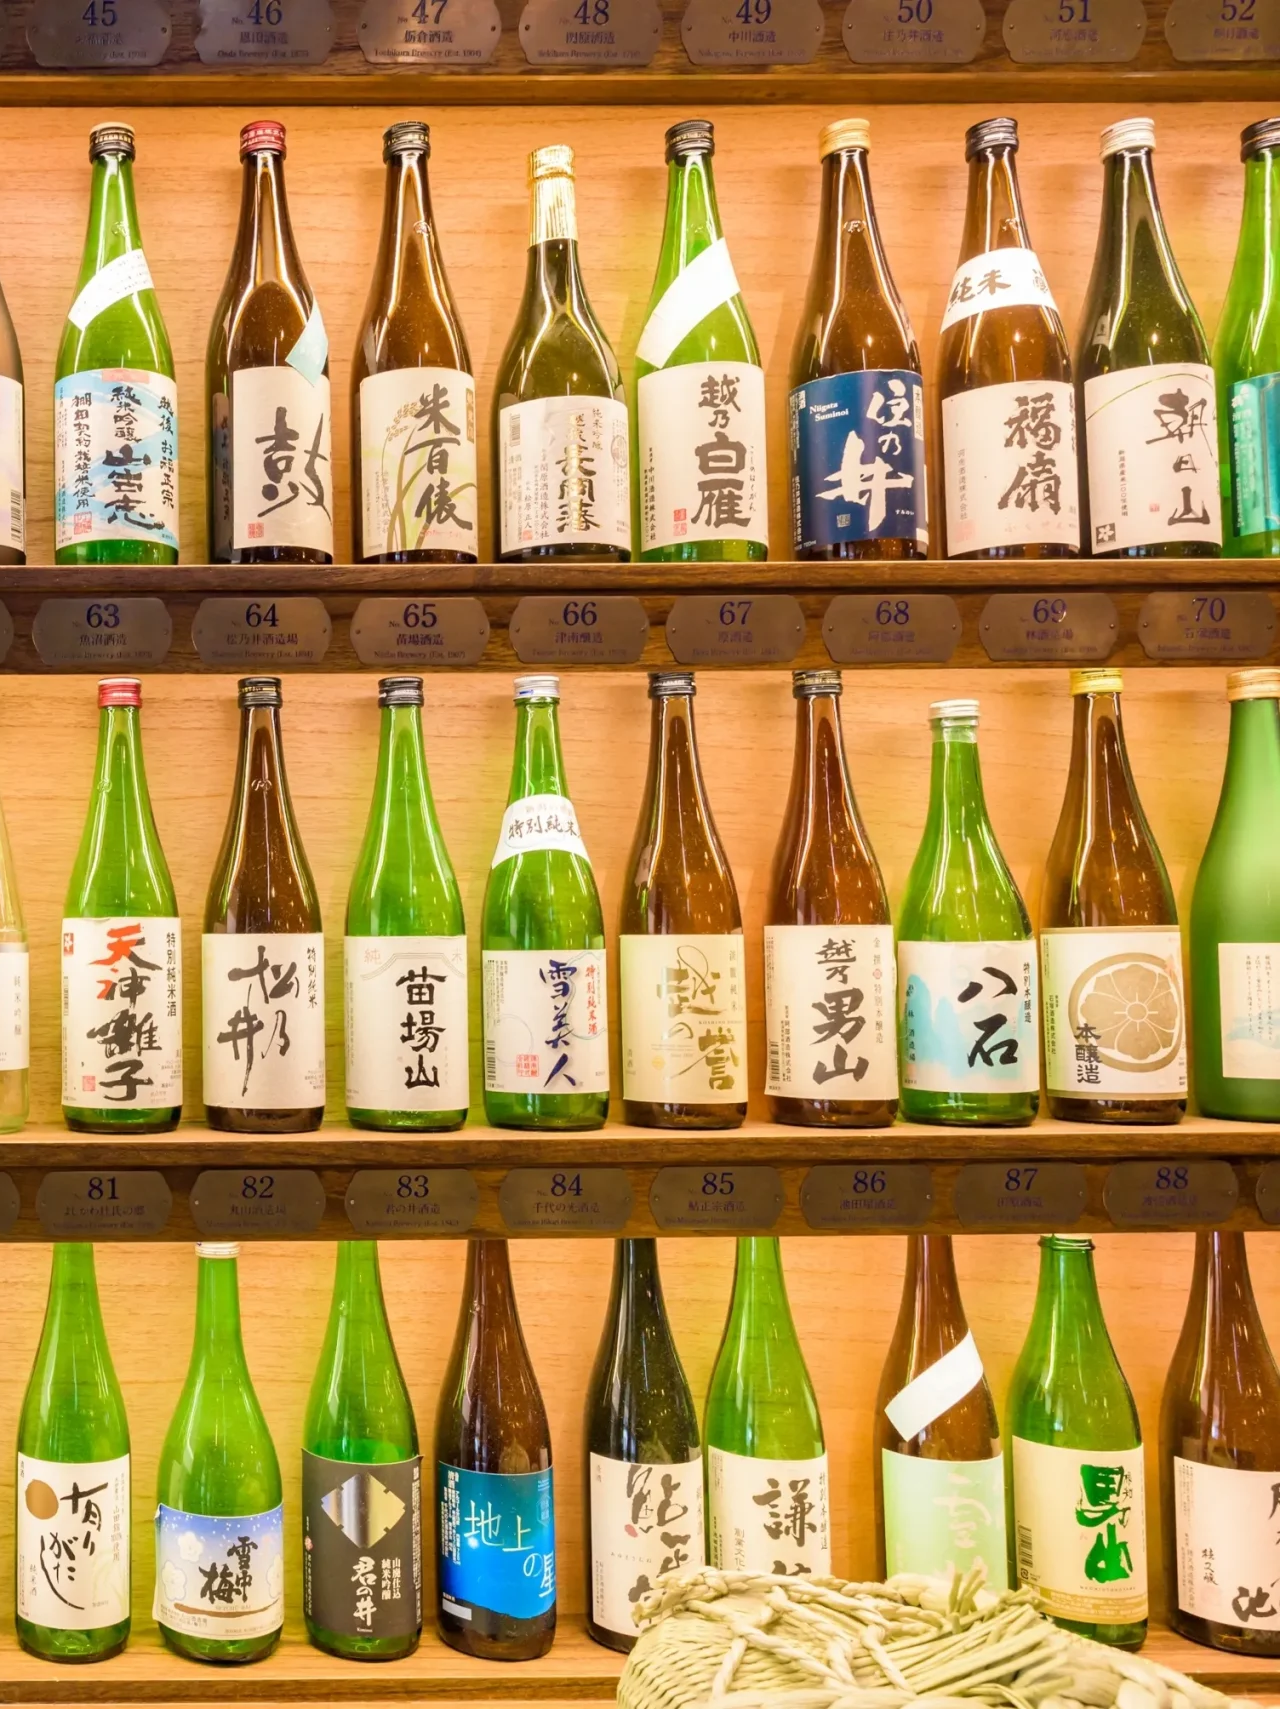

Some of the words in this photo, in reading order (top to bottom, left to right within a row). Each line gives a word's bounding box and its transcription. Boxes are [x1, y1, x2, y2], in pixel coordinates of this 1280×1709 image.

[82, 0, 118, 26] 45
[246, 0, 283, 25] 46
[411, 0, 448, 24] 47
[573, 0, 610, 25] 48
[735, 0, 772, 24] 49
[897, 0, 933, 23] 50
[1058, 0, 1092, 22] 51
[1220, 0, 1256, 21] 52
[728, 30, 777, 43] 中川酒造
[412, 49, 442, 58] Brewery
[110, 385, 143, 444] 純米吟醸
[810, 402, 839, 414] Niigata
[815, 409, 849, 422] Suminoi
[403, 382, 474, 532] 米百俵
[690, 373, 752, 530] 越乃白雁
[814, 378, 915, 533] 住乃井
[1144, 387, 1214, 527] 朝日山
[85, 603, 121, 628] 63
[245, 603, 280, 628] 64
[403, 603, 438, 628] 65
[562, 602, 598, 626] 66
[719, 601, 754, 626] 67
[875, 600, 910, 625] 68
[1032, 599, 1067, 624] 69
[1193, 598, 1226, 623] 70
[397, 651, 427, 661] Brewery
[166, 931, 178, 1018] 特別純米酒
[305, 946, 319, 1010] 特別純米
[584, 964, 598, 1035] 特別純米酒
[809, 937, 871, 1086] 越乃男山
[395, 965, 448, 1089] 苗場山
[538, 958, 577, 1088] 雪美人
[957, 966, 1020, 1069] 八石
[1074, 1022, 1102, 1085] 本醸造
[87, 1176, 121, 1200] 81
[242, 1175, 275, 1199] 82
[396, 1175, 430, 1198] 83
[550, 1173, 584, 1197] 84
[701, 1171, 735, 1196] 85
[852, 1170, 887, 1194] 86
[1005, 1168, 1039, 1192] 87
[1155, 1165, 1189, 1190] 88
[463, 1499, 556, 1599] 地上の星
[380, 1556, 392, 1600] 純米吟醸
[350, 1555, 378, 1627] 君の井
